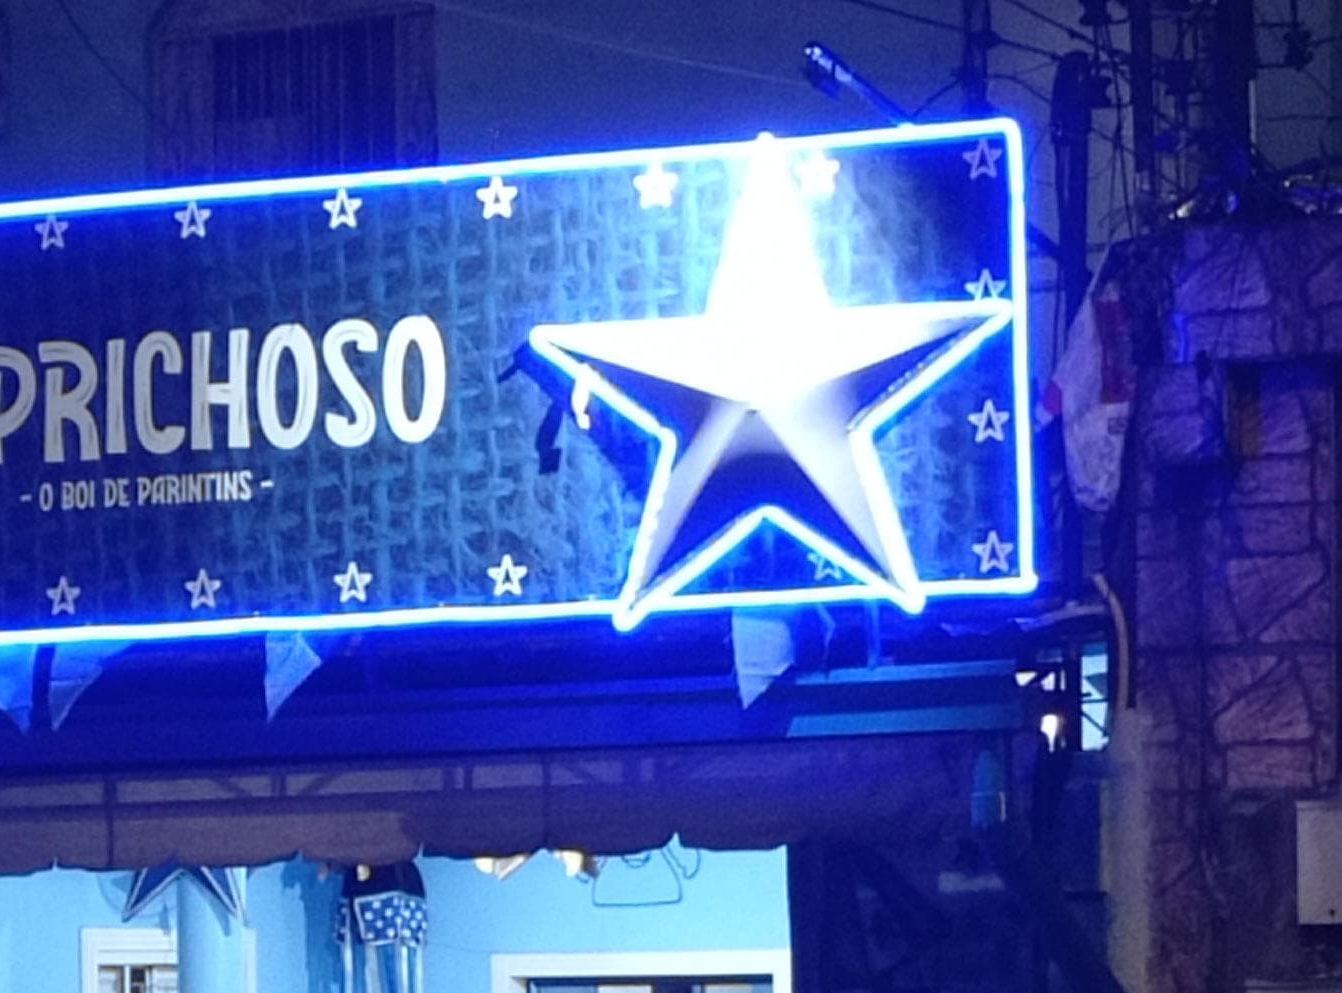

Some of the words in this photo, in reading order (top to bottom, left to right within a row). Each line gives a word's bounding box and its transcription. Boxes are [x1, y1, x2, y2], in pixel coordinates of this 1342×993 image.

[39, 481, 54, 512] O
[60, 480, 96, 511] BOI
[103, 478, 130, 508] DE
[137, 469, 253, 506] PARINTINS
